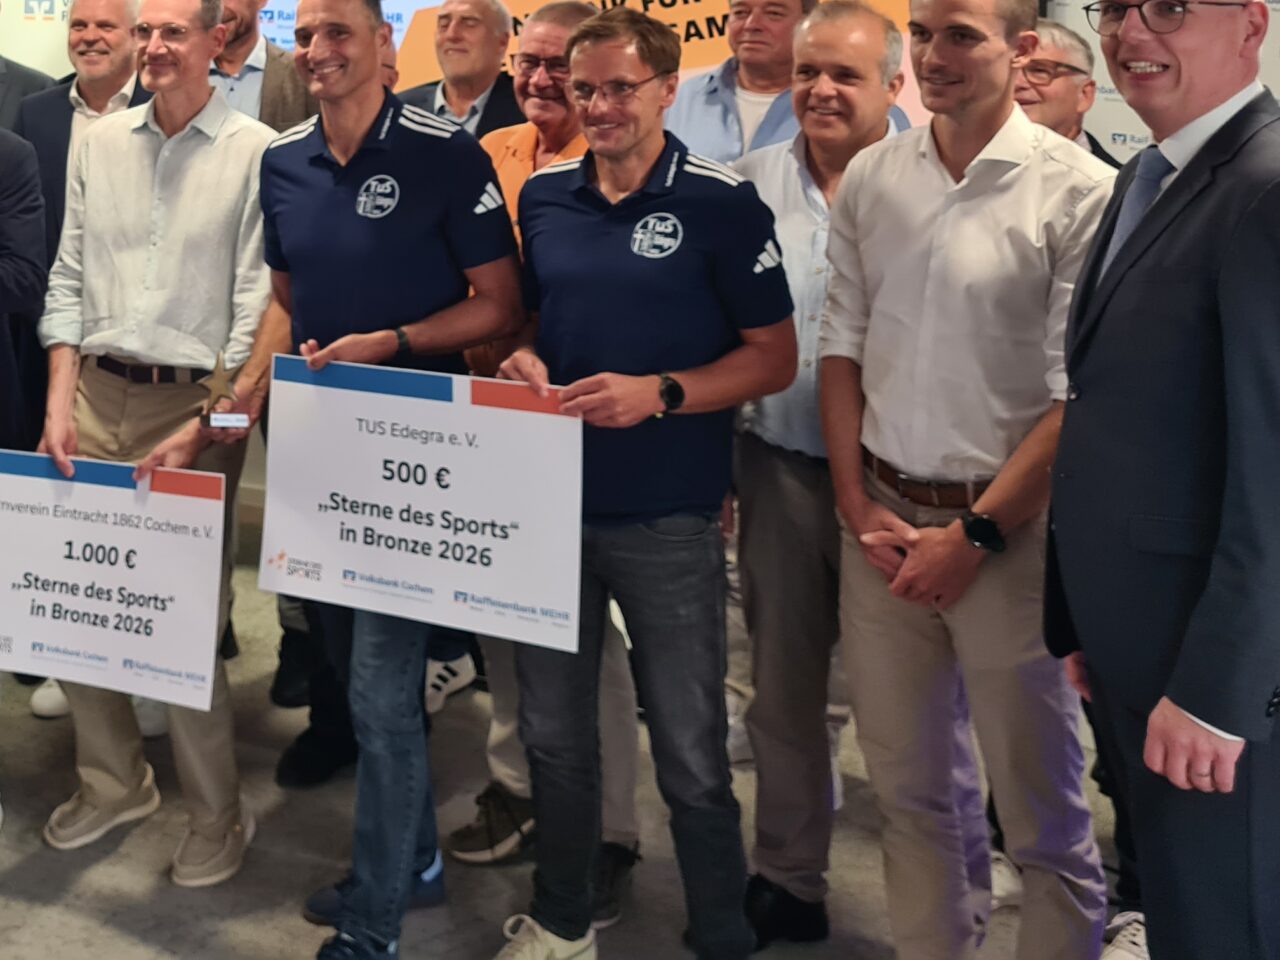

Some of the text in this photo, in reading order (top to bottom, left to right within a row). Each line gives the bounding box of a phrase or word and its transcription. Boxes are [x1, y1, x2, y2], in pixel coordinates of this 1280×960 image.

[669, 14, 729, 43] AM
[356, 417, 479, 448] TUS Edegra e. V.
[381, 458, 451, 489] 500 €
[53, 504, 108, 524] Eintracht
[112, 512, 142, 529] 1862
[144, 517, 190, 536] Cochem
[192, 525, 202, 537] e.
[203, 525, 214, 539] V.
[317, 492, 519, 540] „Sterne des Sports“
[63, 540, 137, 569] 1.000 €
[339, 522, 492, 567] in Bronze 2026
[11, 572, 175, 612] „Sterne des Sports“
[30, 599, 154, 637] in Bronze 2026
